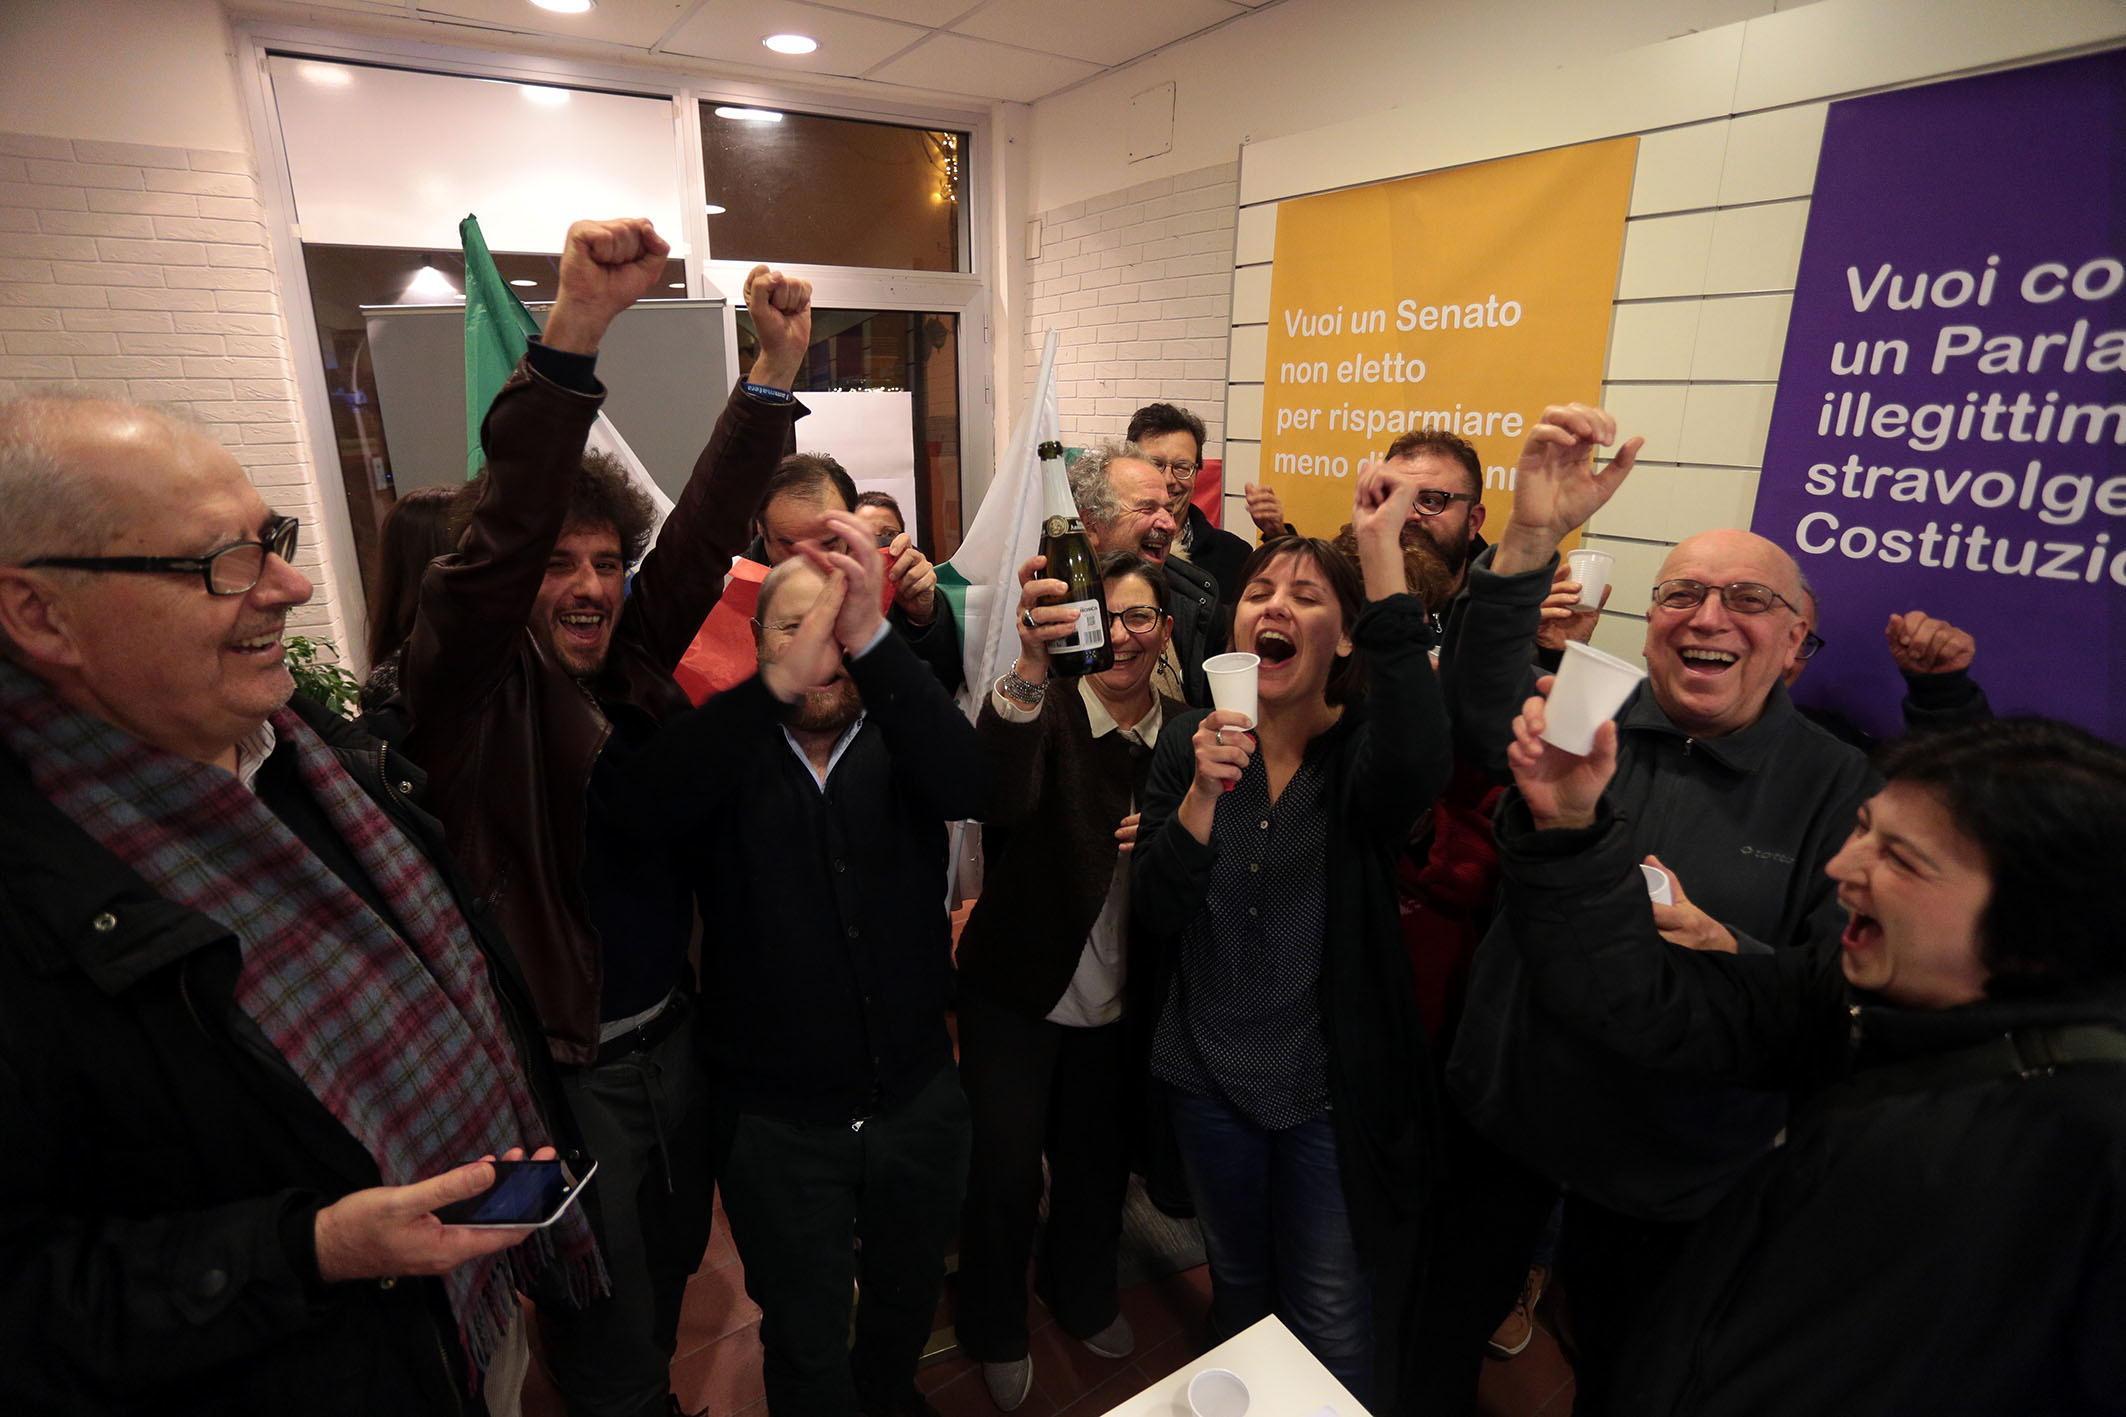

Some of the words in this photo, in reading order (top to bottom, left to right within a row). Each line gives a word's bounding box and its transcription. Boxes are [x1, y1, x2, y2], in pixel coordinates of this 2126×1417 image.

[1847, 255, 1999, 312] Vuoi
[2021, 258, 2125, 303] co
[1284, 305, 1343, 337] Vuoi
[1351, 309, 1386, 334] un
[1396, 294, 1522, 332] Senato
[1281, 361, 1328, 384] non
[1336, 352, 1426, 384] eletto
[1831, 340, 1908, 375] un
[1931, 319, 2126, 375] Parla
[1277, 407, 1322, 435] per
[1329, 403, 1523, 438] risparmiare
[1818, 391, 2126, 451] illegittim
[1275, 452, 1348, 478] meno
[1805, 455, 2126, 525] stravolge
